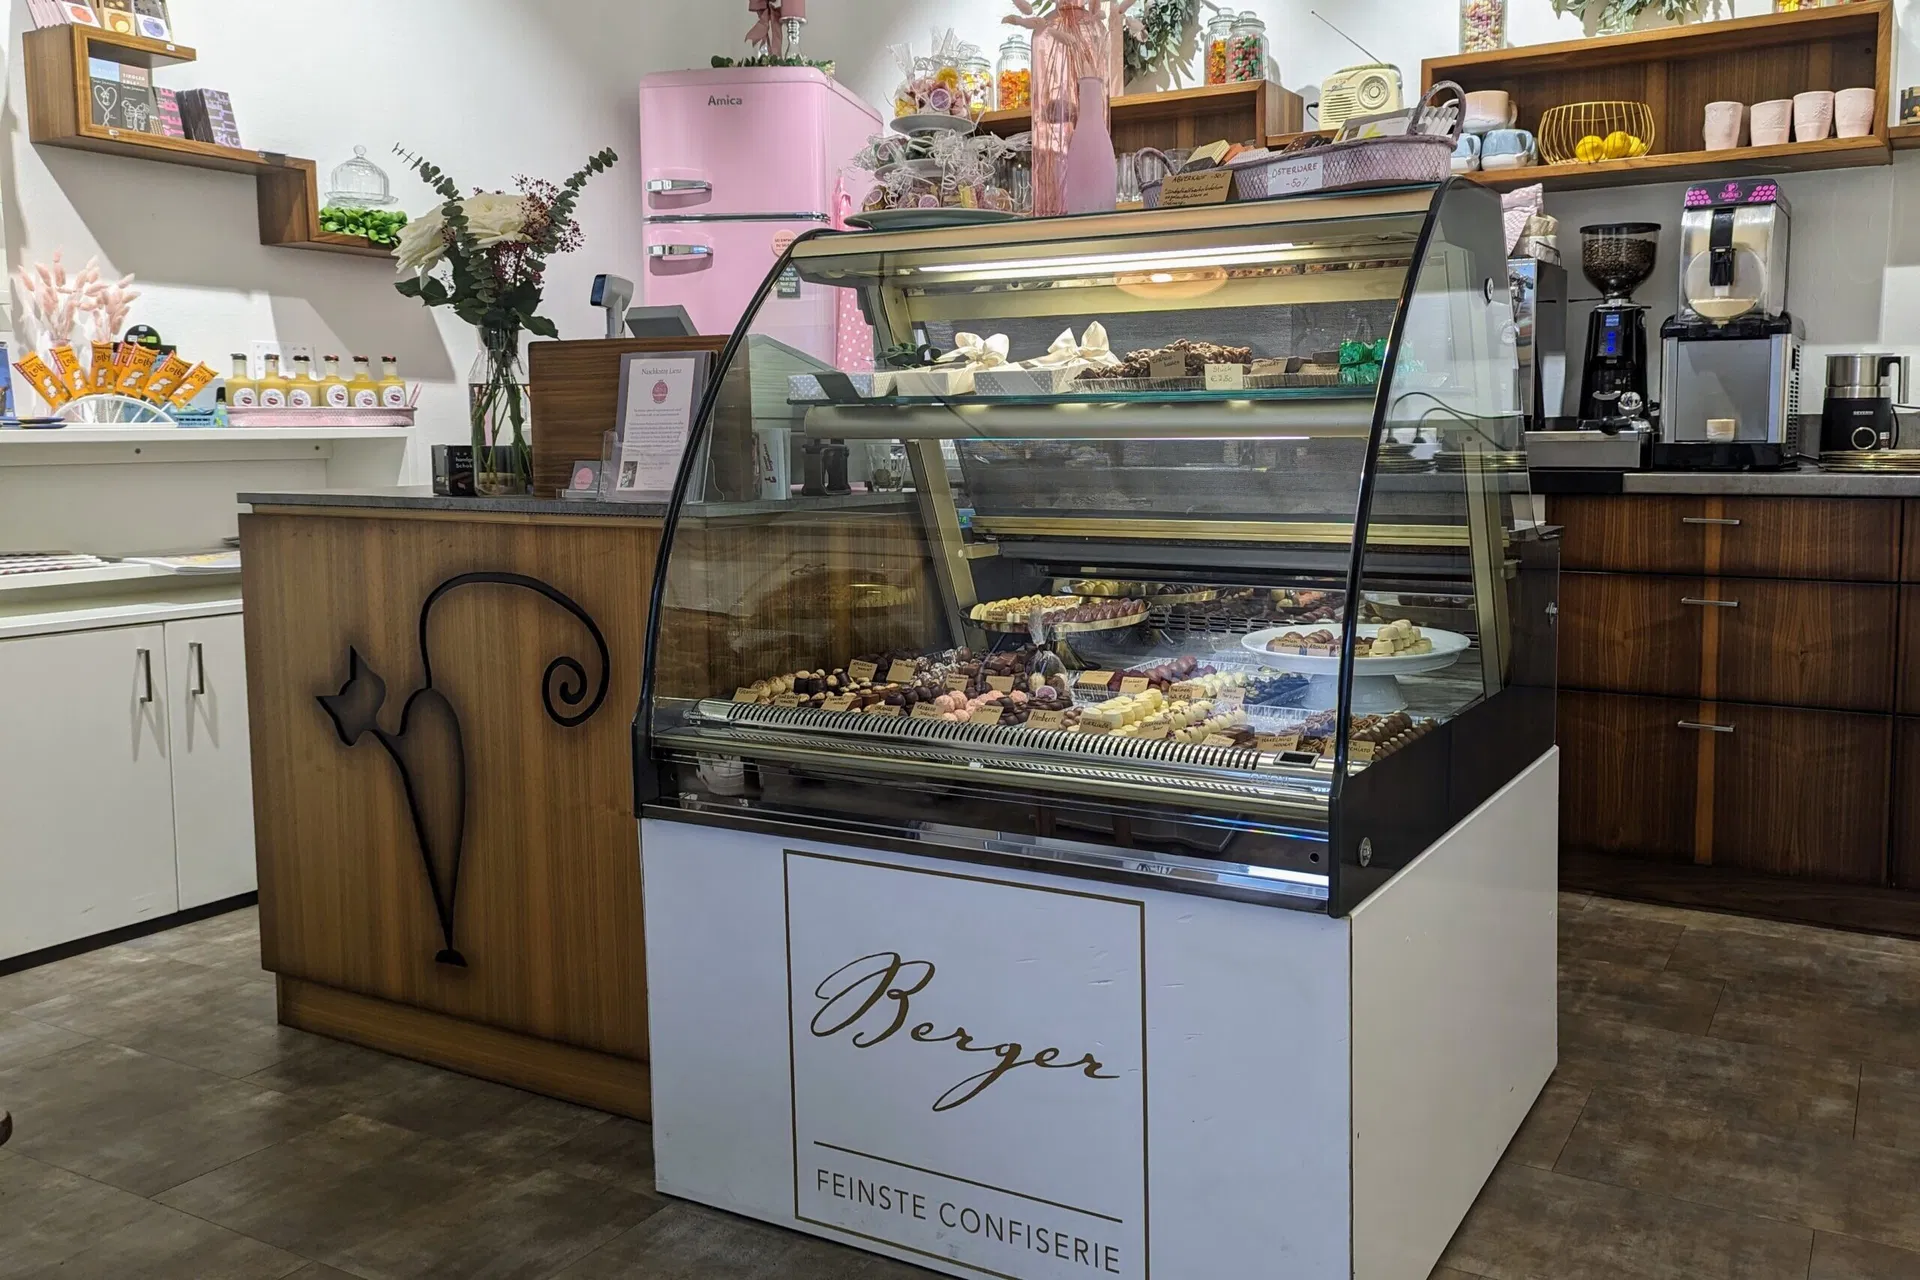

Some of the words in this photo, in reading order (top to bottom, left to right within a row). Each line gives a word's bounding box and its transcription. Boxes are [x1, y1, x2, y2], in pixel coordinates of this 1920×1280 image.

[708, 94, 742, 106] Amica
[1271, 163, 1318, 178] OSTERWARE
[810, 951, 1120, 1112] Berger
[817, 1168, 926, 1221] FEINSTE
[939, 1202, 1121, 1275] CONFISERIE
